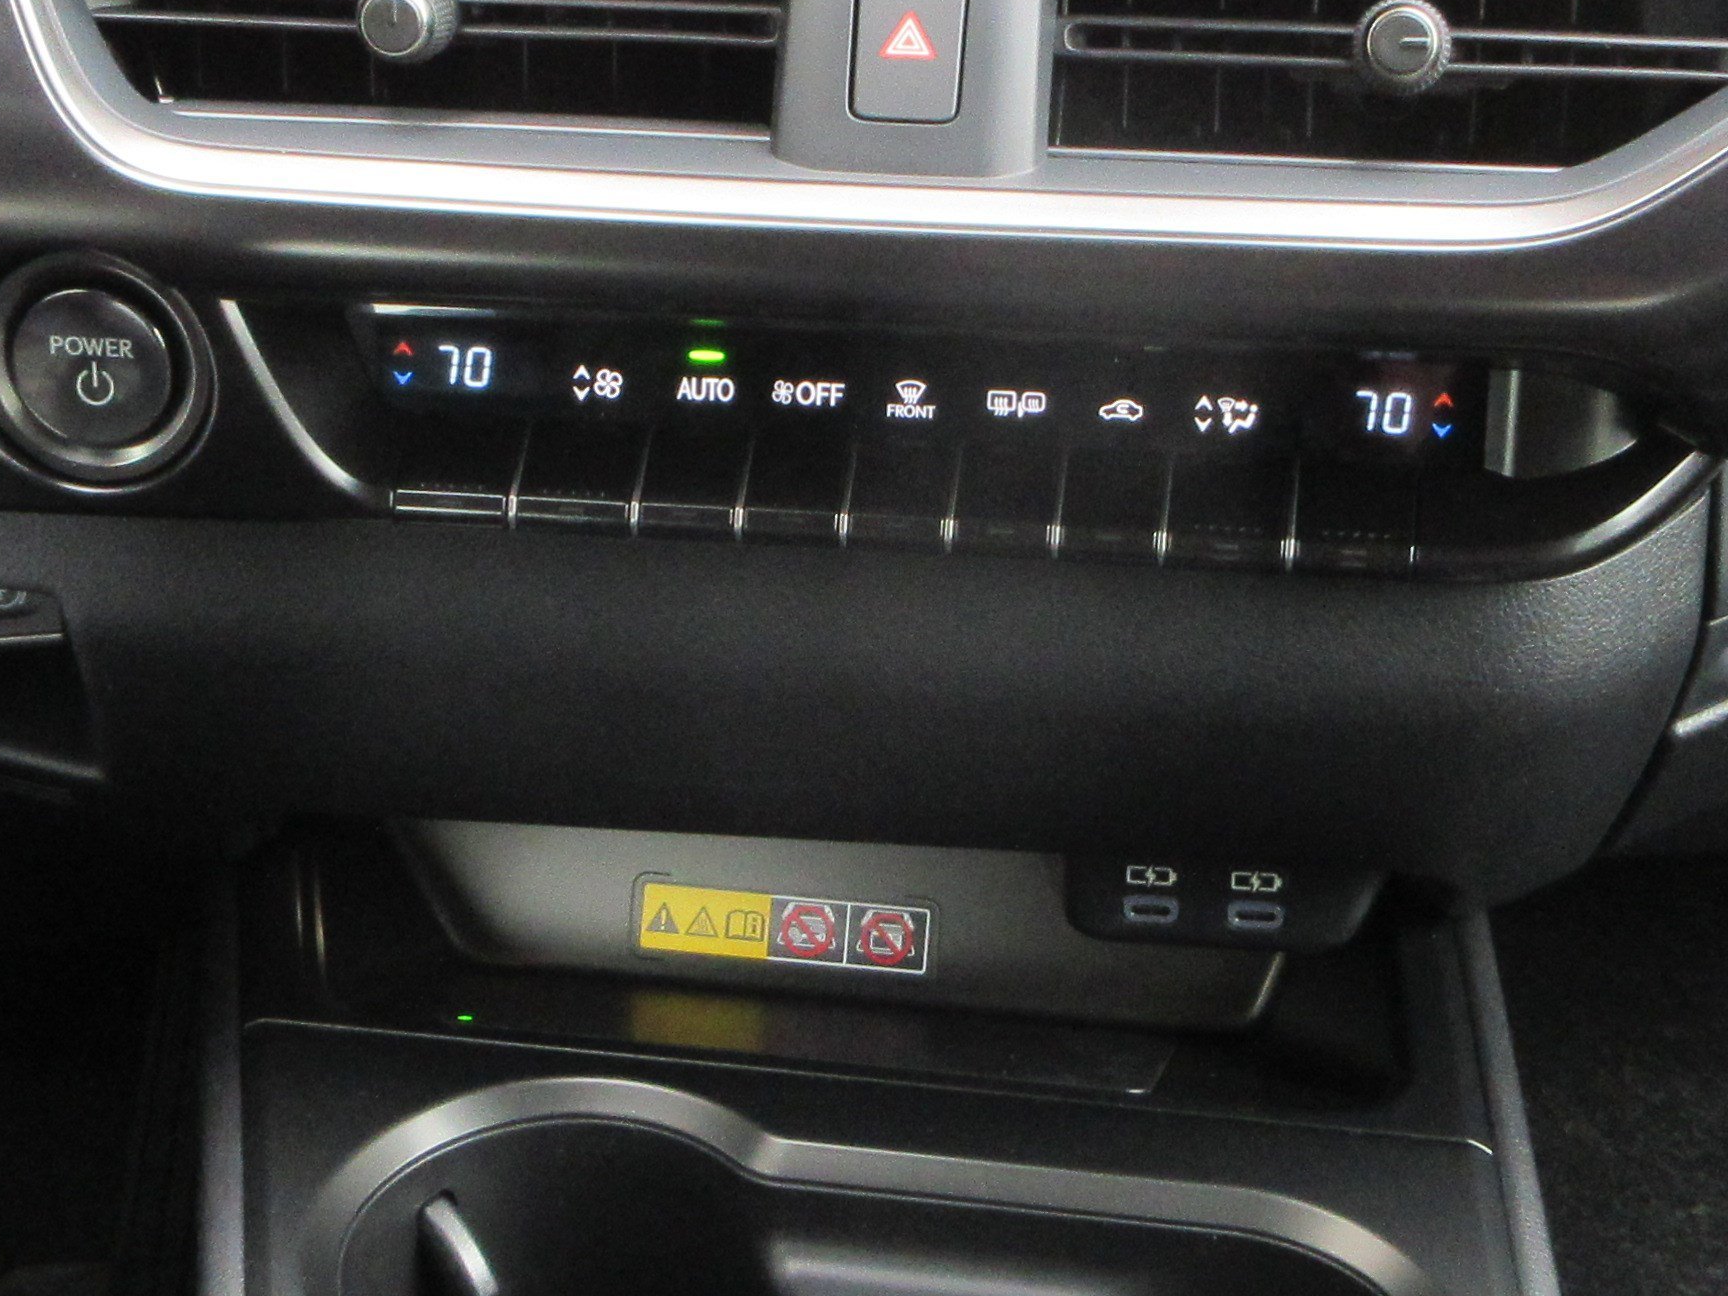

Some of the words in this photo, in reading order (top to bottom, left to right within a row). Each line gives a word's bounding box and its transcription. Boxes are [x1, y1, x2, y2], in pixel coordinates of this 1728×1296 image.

[48, 334, 134, 360] POWER
[438, 344, 493, 389] 70
[677, 376, 735, 403] AUTO
[796, 381, 846, 407] OFF
[886, 403, 937, 420] FRONT
[1355, 390, 1413, 435] 70
